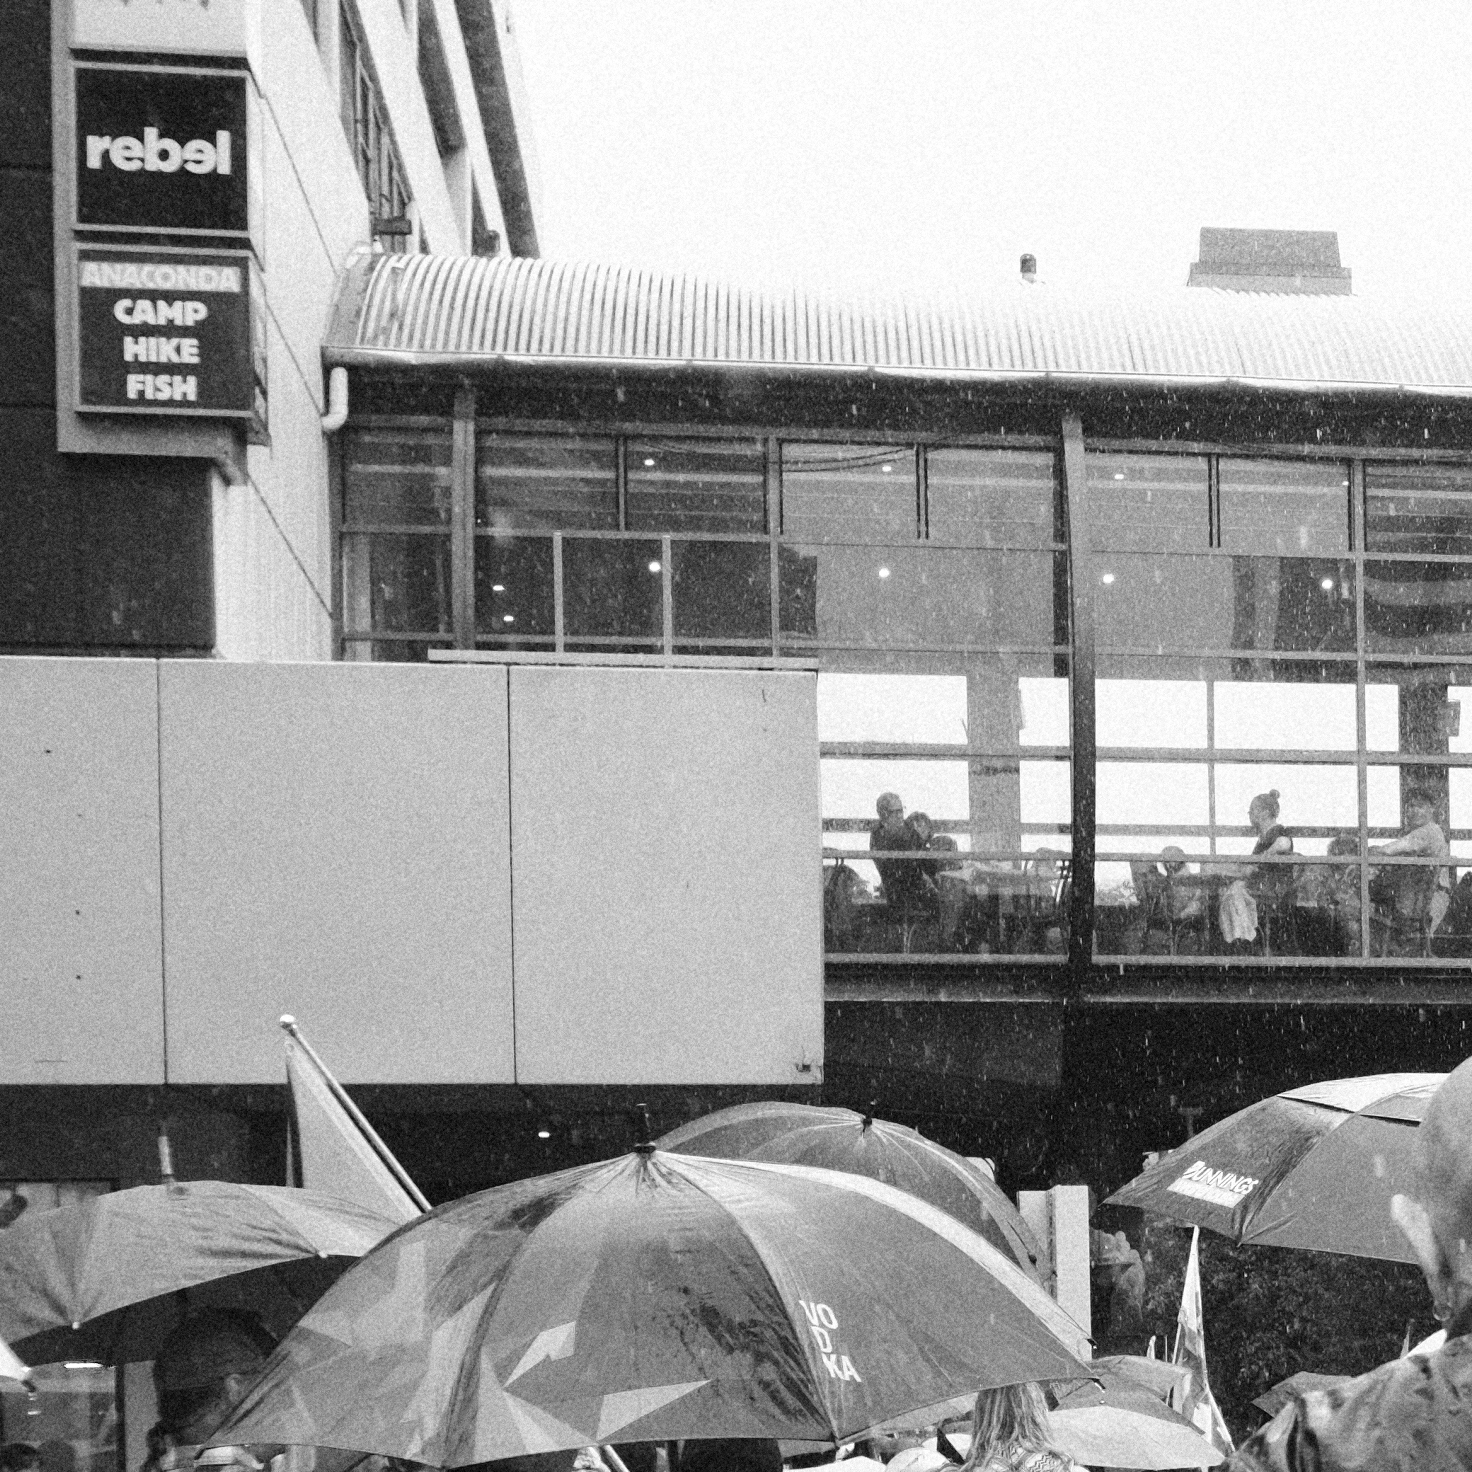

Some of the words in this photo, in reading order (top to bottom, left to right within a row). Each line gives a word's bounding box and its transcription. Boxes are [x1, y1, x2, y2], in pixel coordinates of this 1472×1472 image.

[86, 126, 231, 175] rebel
[80, 261, 242, 293] ANACONDA
[113, 298, 208, 326] CAMP
[123, 336, 200, 364] HIKE
[126, 373, 197, 401] FISH
